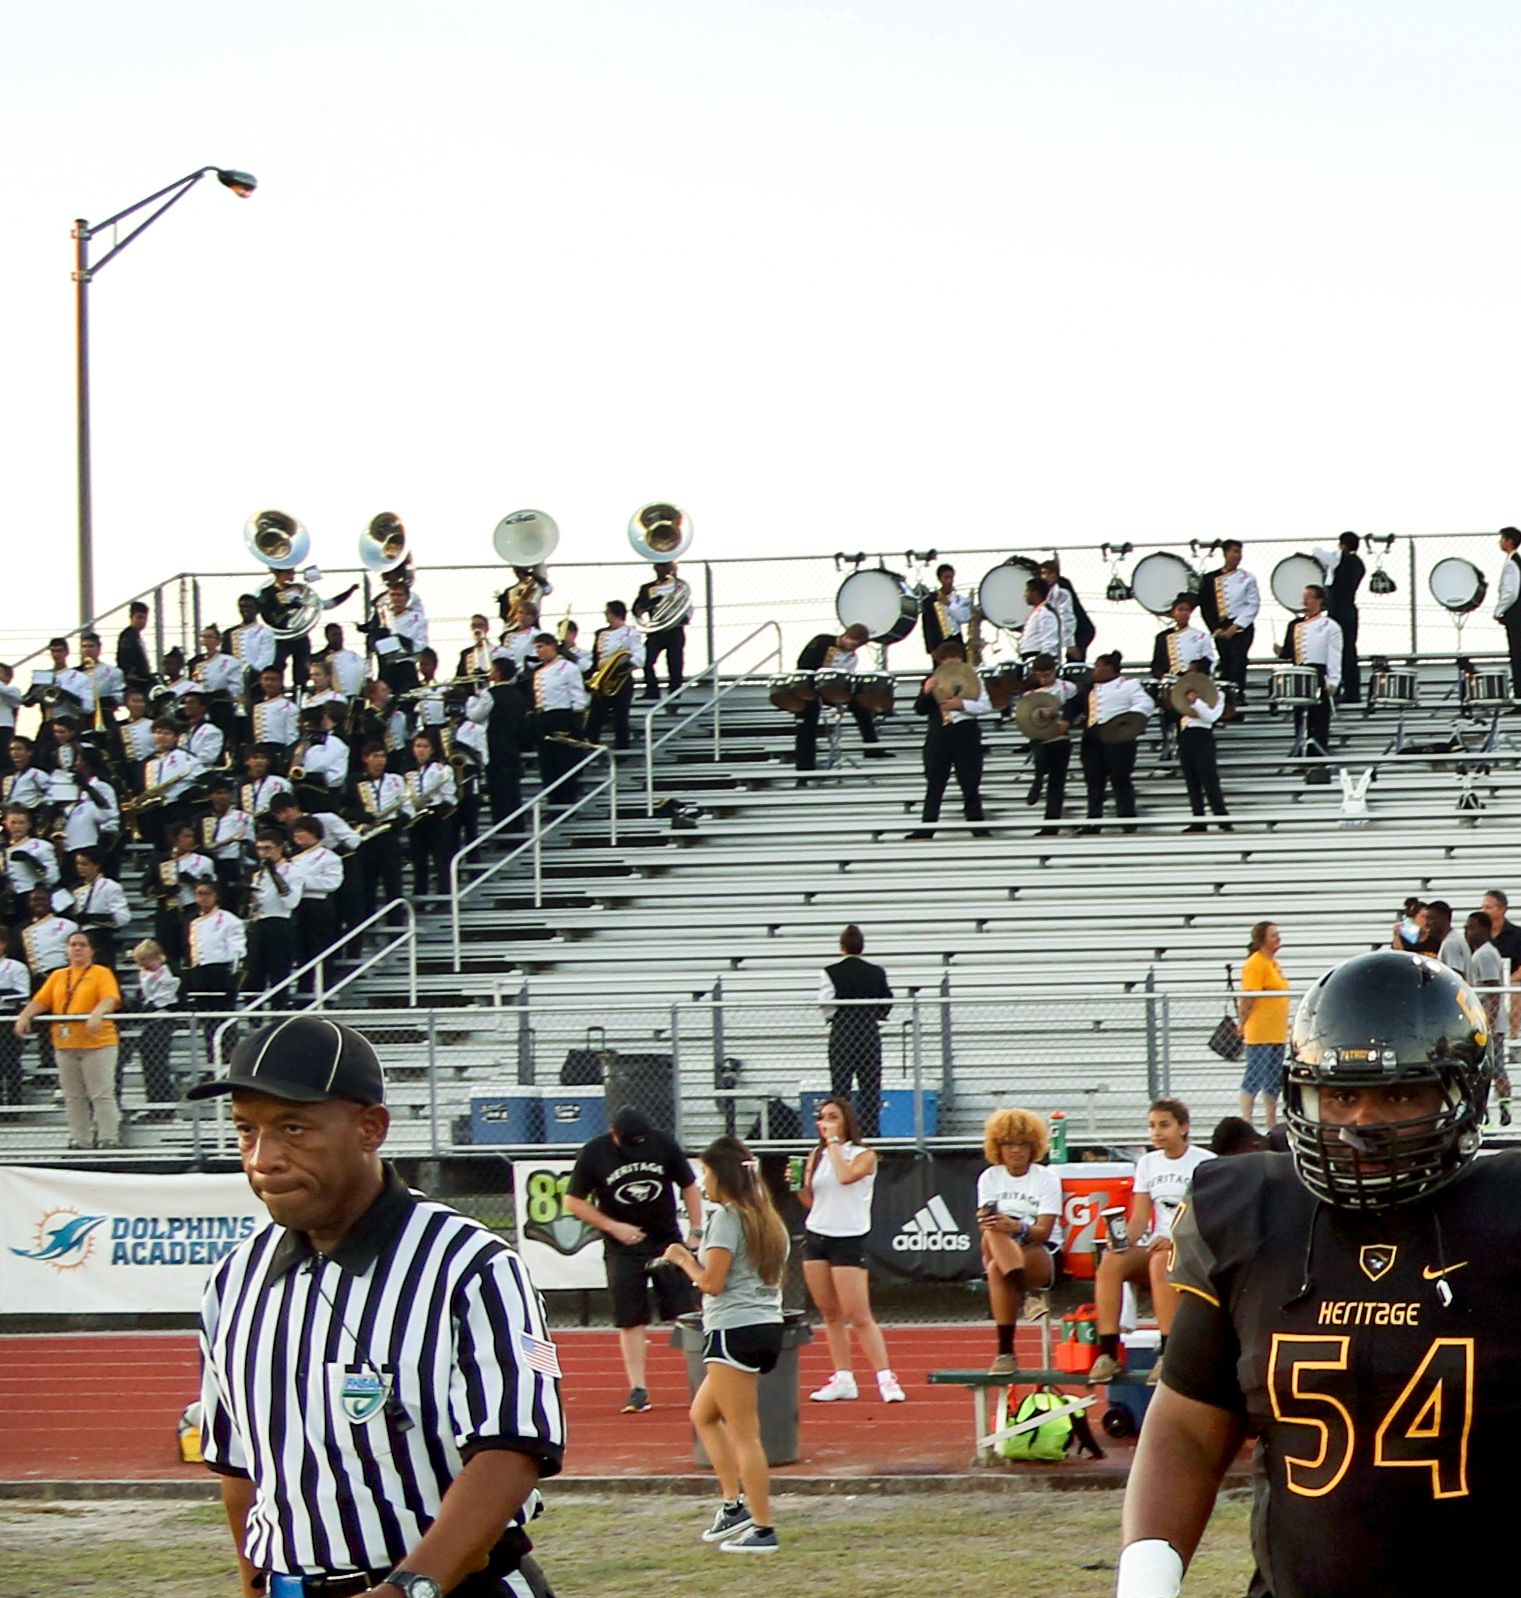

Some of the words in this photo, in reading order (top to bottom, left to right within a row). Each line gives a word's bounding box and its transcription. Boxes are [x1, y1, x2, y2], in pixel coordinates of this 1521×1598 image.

[111, 1216, 256, 1240] DOLPHINS
[892, 1229, 972, 1251] adidas
[111, 1241, 240, 1266] ACADEM
[1318, 1301, 1421, 1326] HERITAGE
[1267, 1333, 1475, 1500] 54
